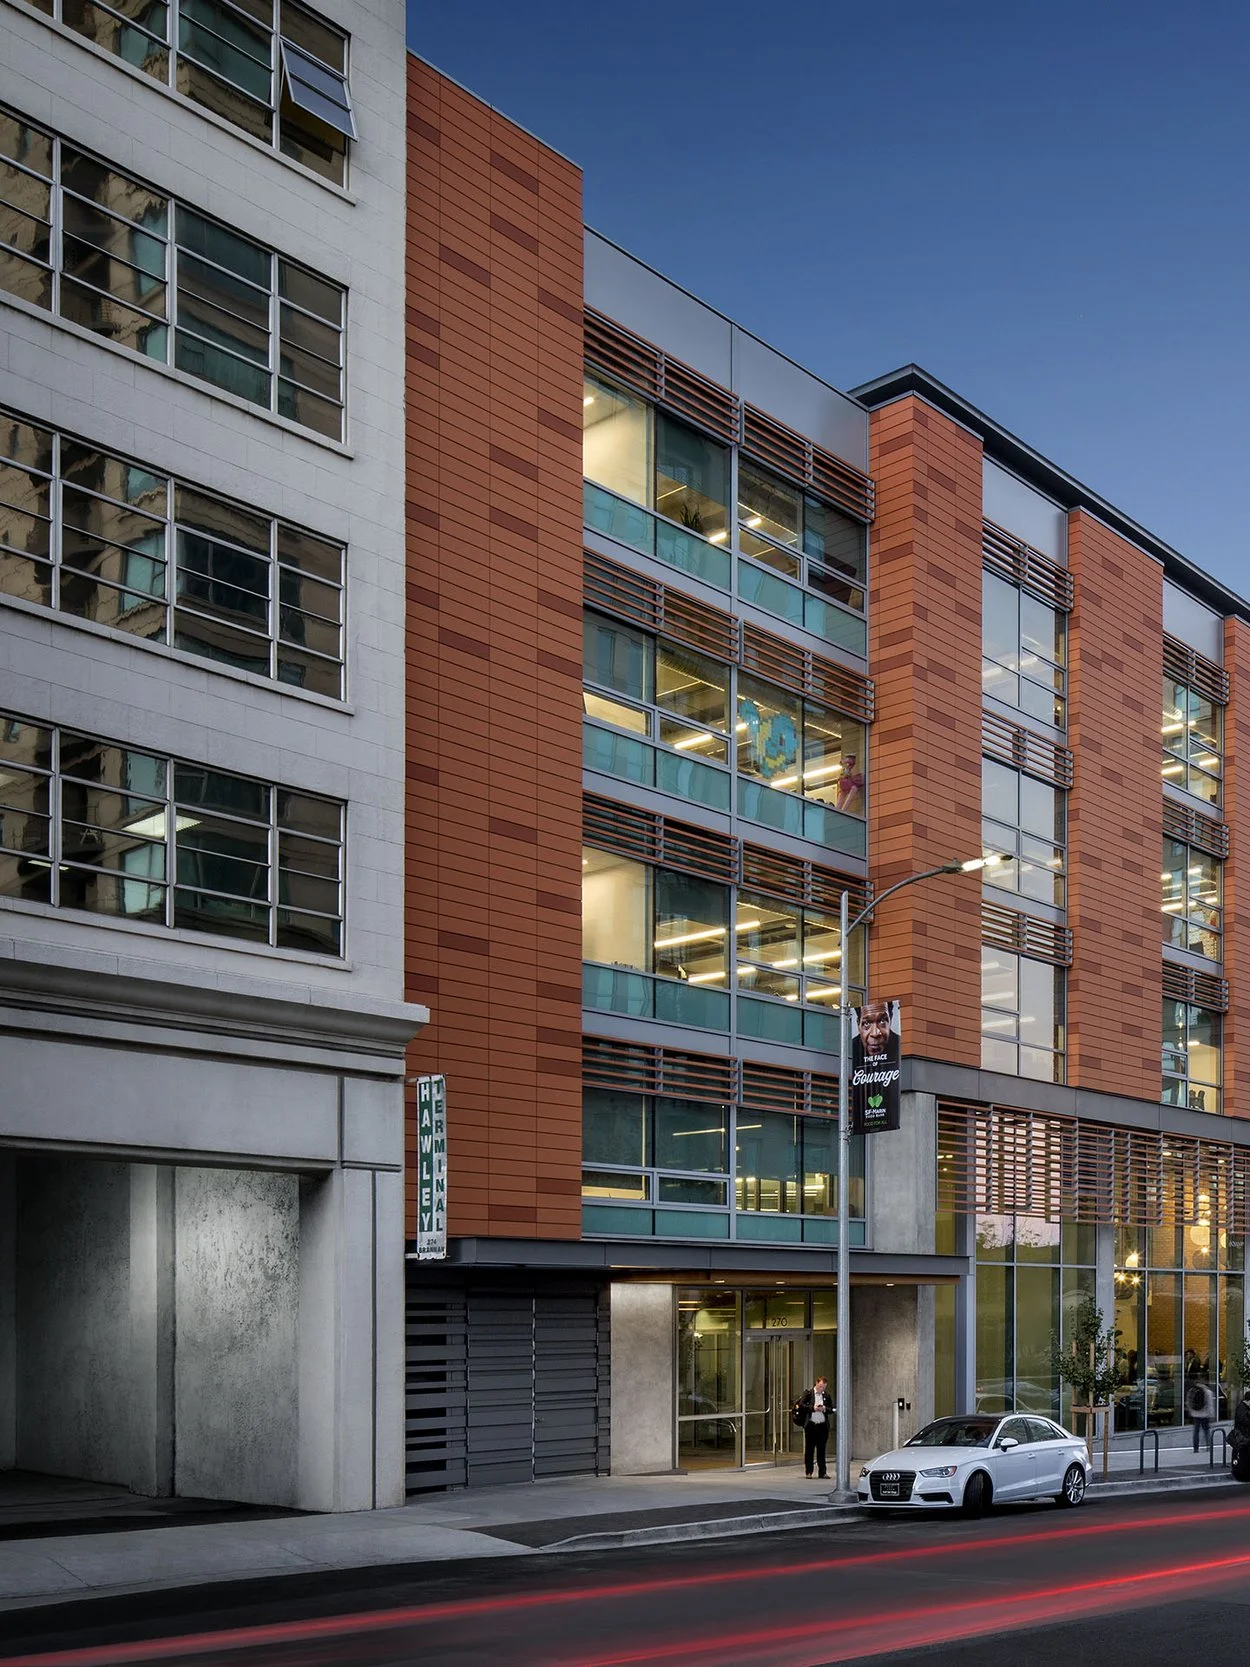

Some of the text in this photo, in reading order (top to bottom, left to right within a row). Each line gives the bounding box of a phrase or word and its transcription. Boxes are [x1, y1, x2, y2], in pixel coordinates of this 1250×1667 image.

[852, 1069, 900, 1087] Courage
[421, 1083, 432, 1232] HAWLEY
[434, 1080, 445, 1231] TERMINAL
[772, 1317, 788, 1327] 270
